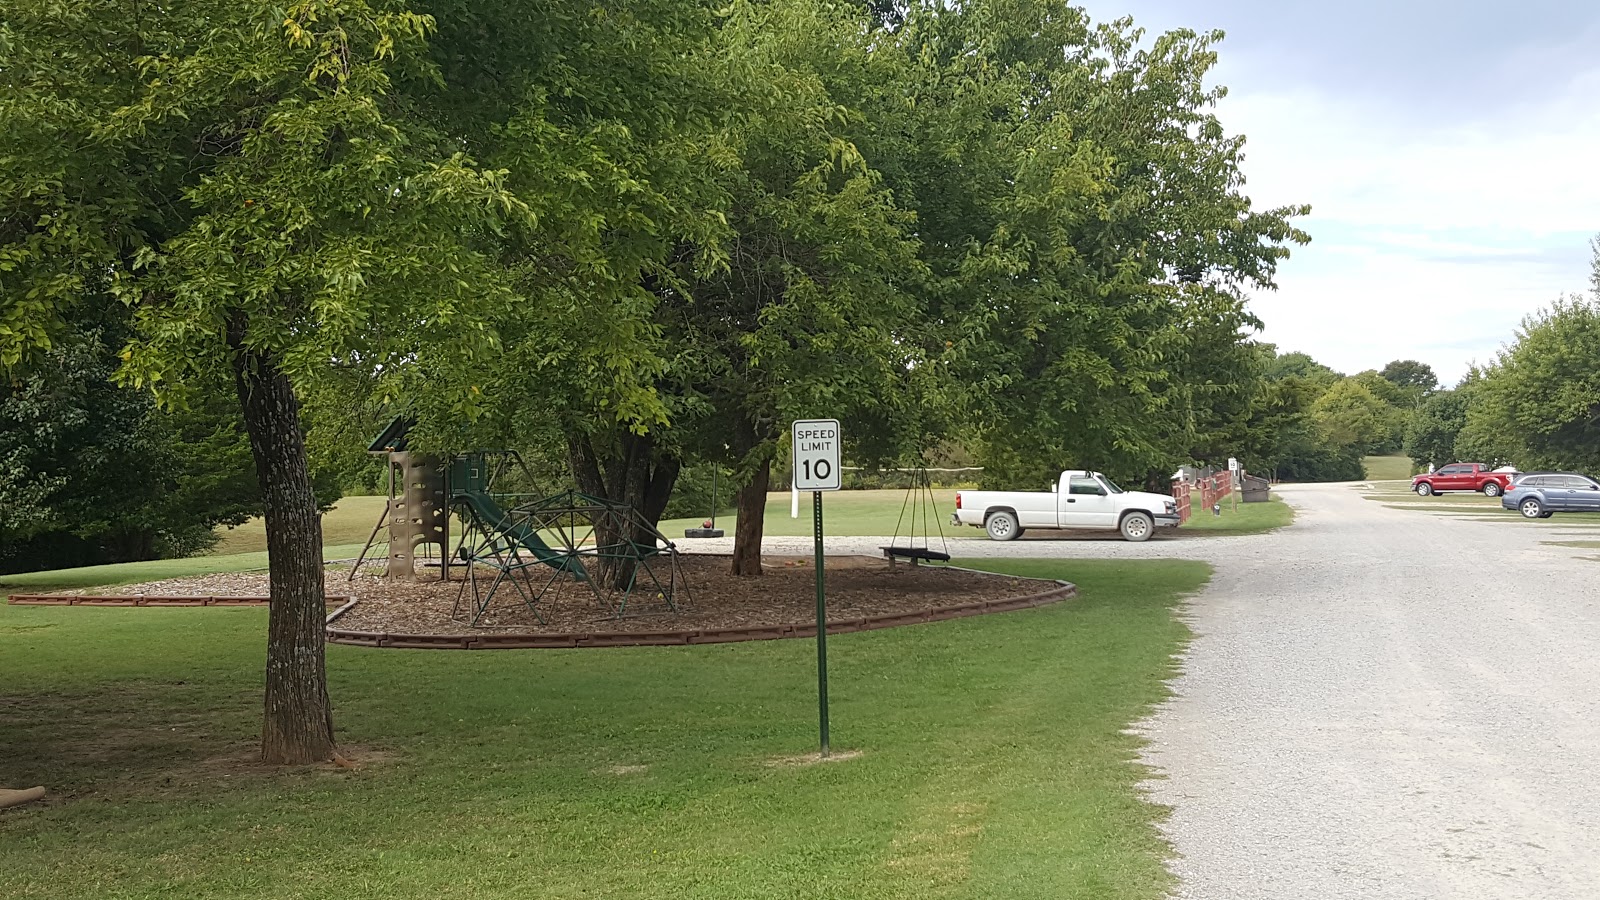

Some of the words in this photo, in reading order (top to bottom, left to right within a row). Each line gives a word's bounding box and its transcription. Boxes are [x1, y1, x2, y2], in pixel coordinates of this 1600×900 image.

[797, 430, 835, 439] SPEED
[801, 442, 831, 451] LIMIT
[802, 458, 831, 480] 10
